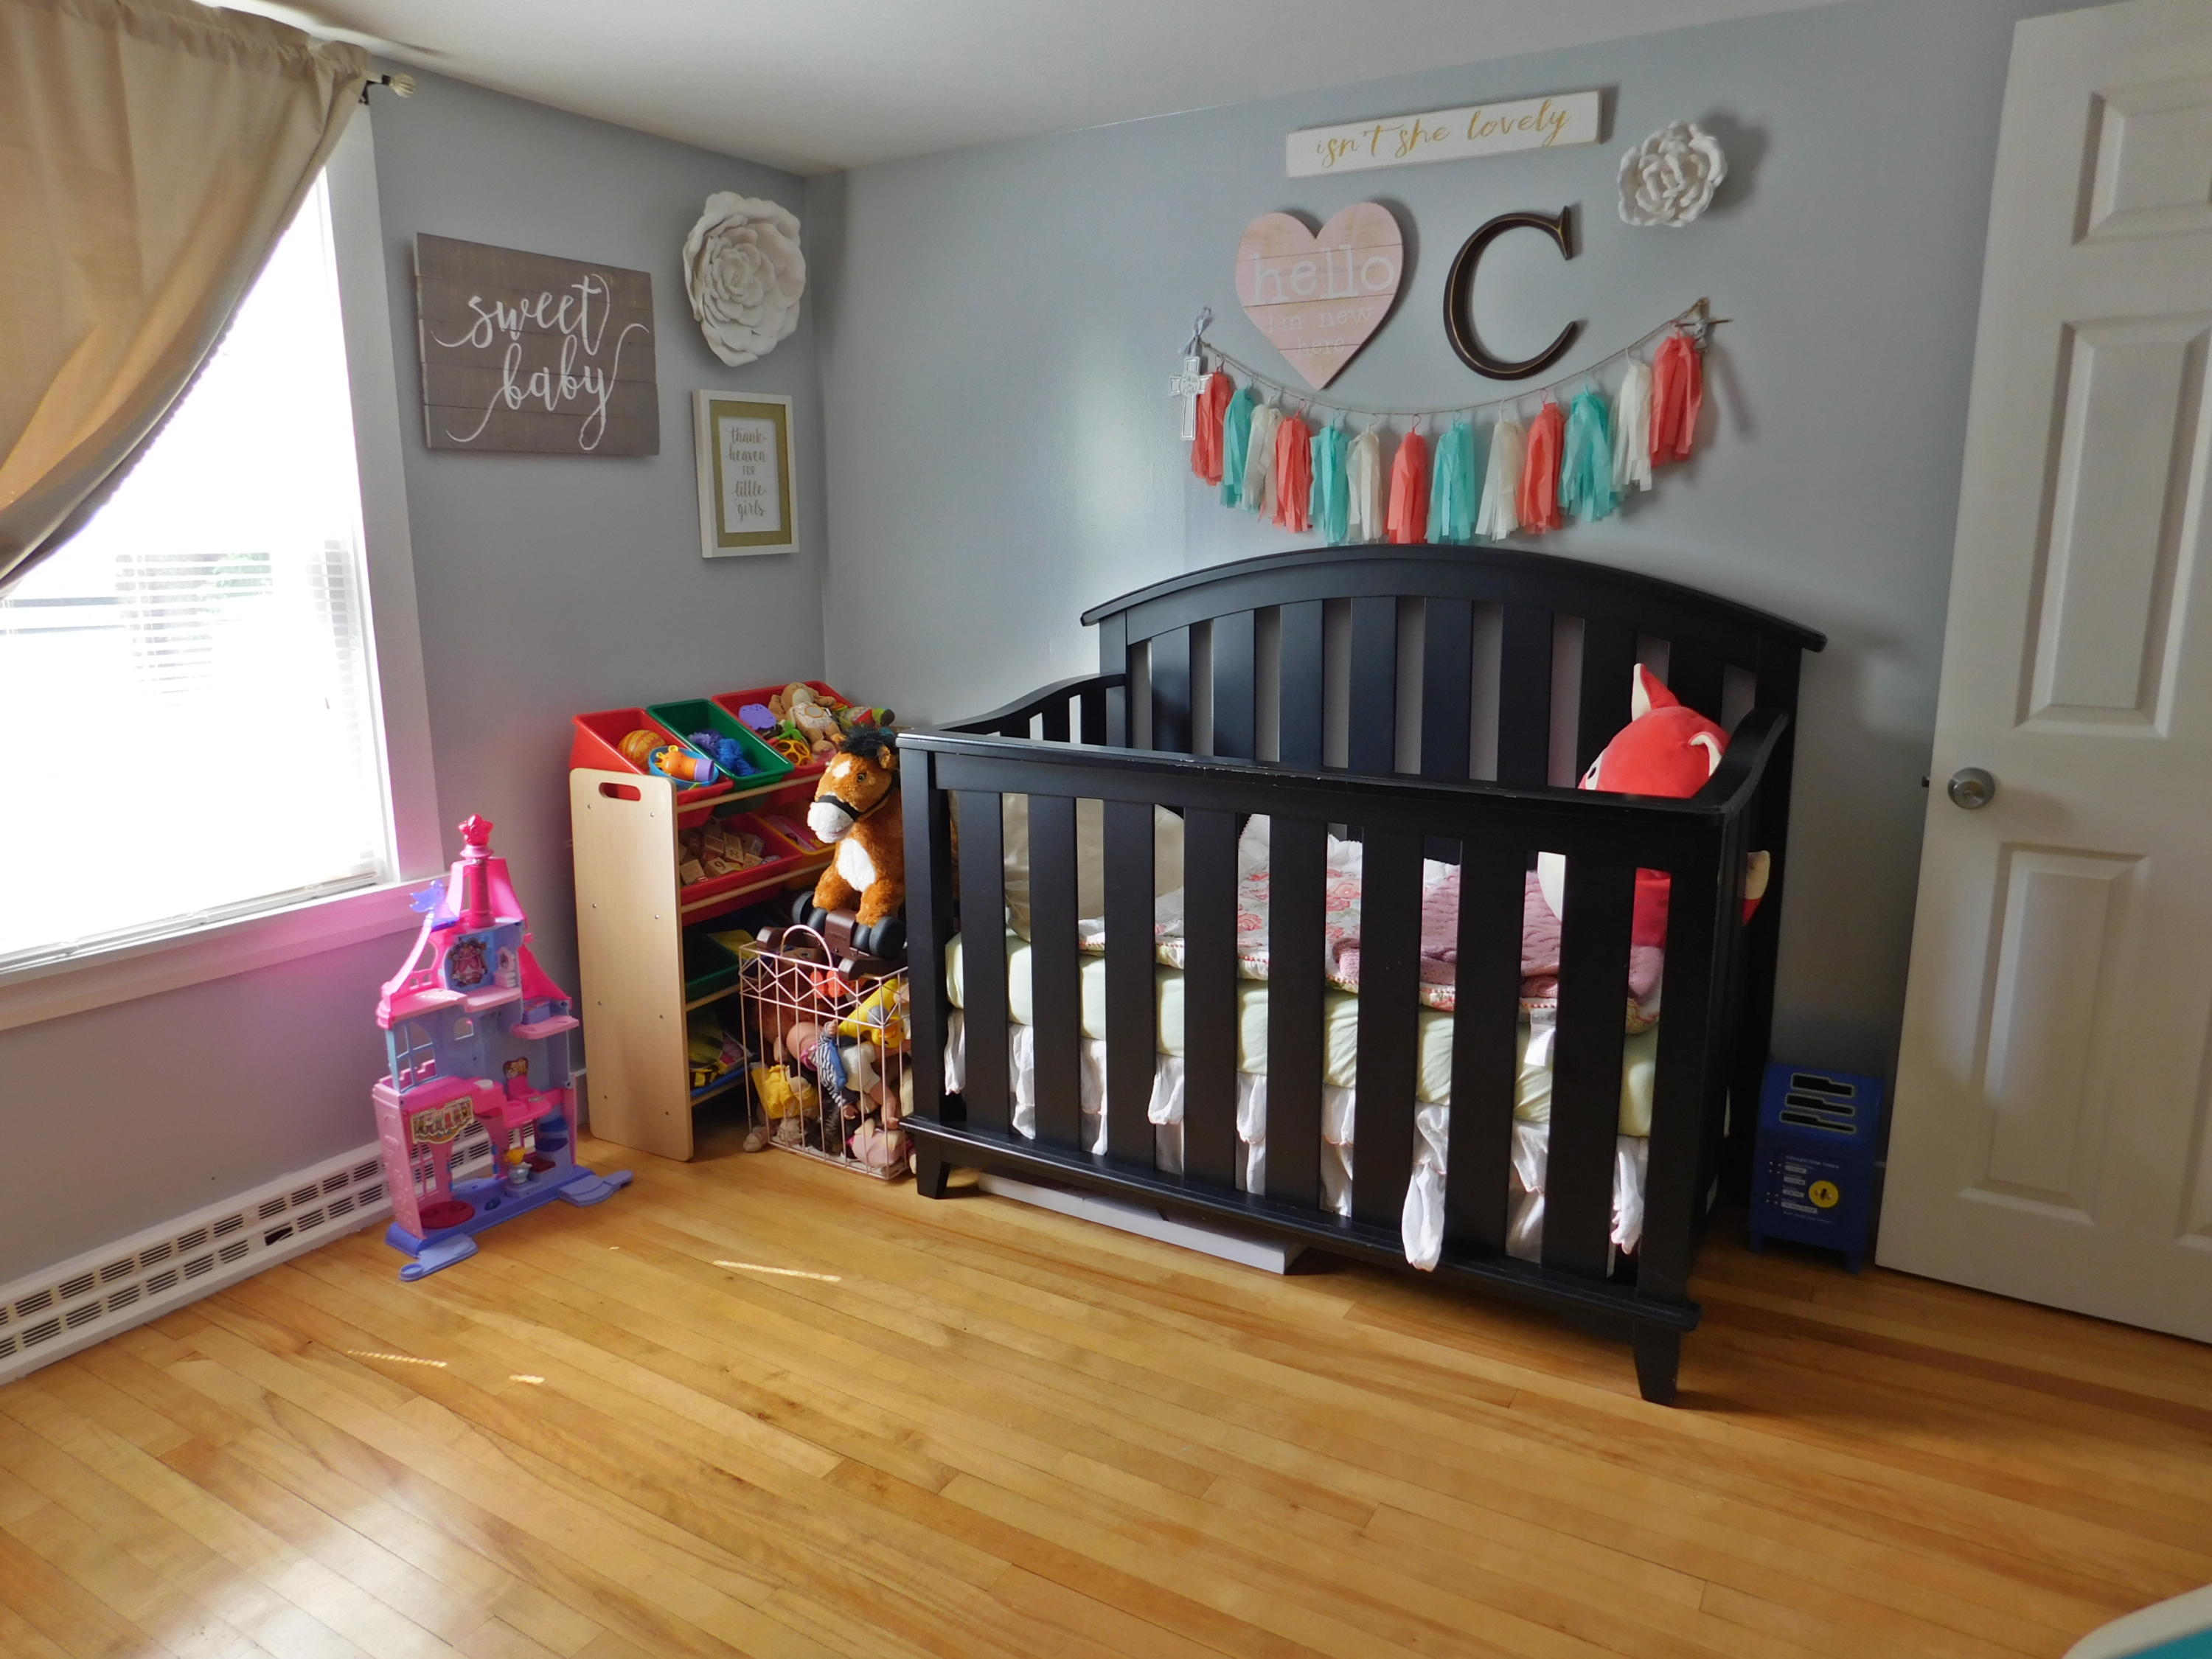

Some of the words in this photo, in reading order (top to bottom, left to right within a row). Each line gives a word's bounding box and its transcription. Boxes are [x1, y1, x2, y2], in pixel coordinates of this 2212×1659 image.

[1394, 119, 1450, 159] she
[1467, 99, 1571, 148] lovely
[1250, 244, 1395, 306] hello
[1443, 205, 1578, 381] C
[431, 274, 610, 355] sweet
[1318, 307, 1374, 329] new
[1296, 336, 1346, 358] here
[445, 323, 650, 451] baby
[726, 425, 766, 444] thank
[726, 442, 768, 462] heaven
[732, 480, 766, 497] little
[735, 498, 765, 522] girls
